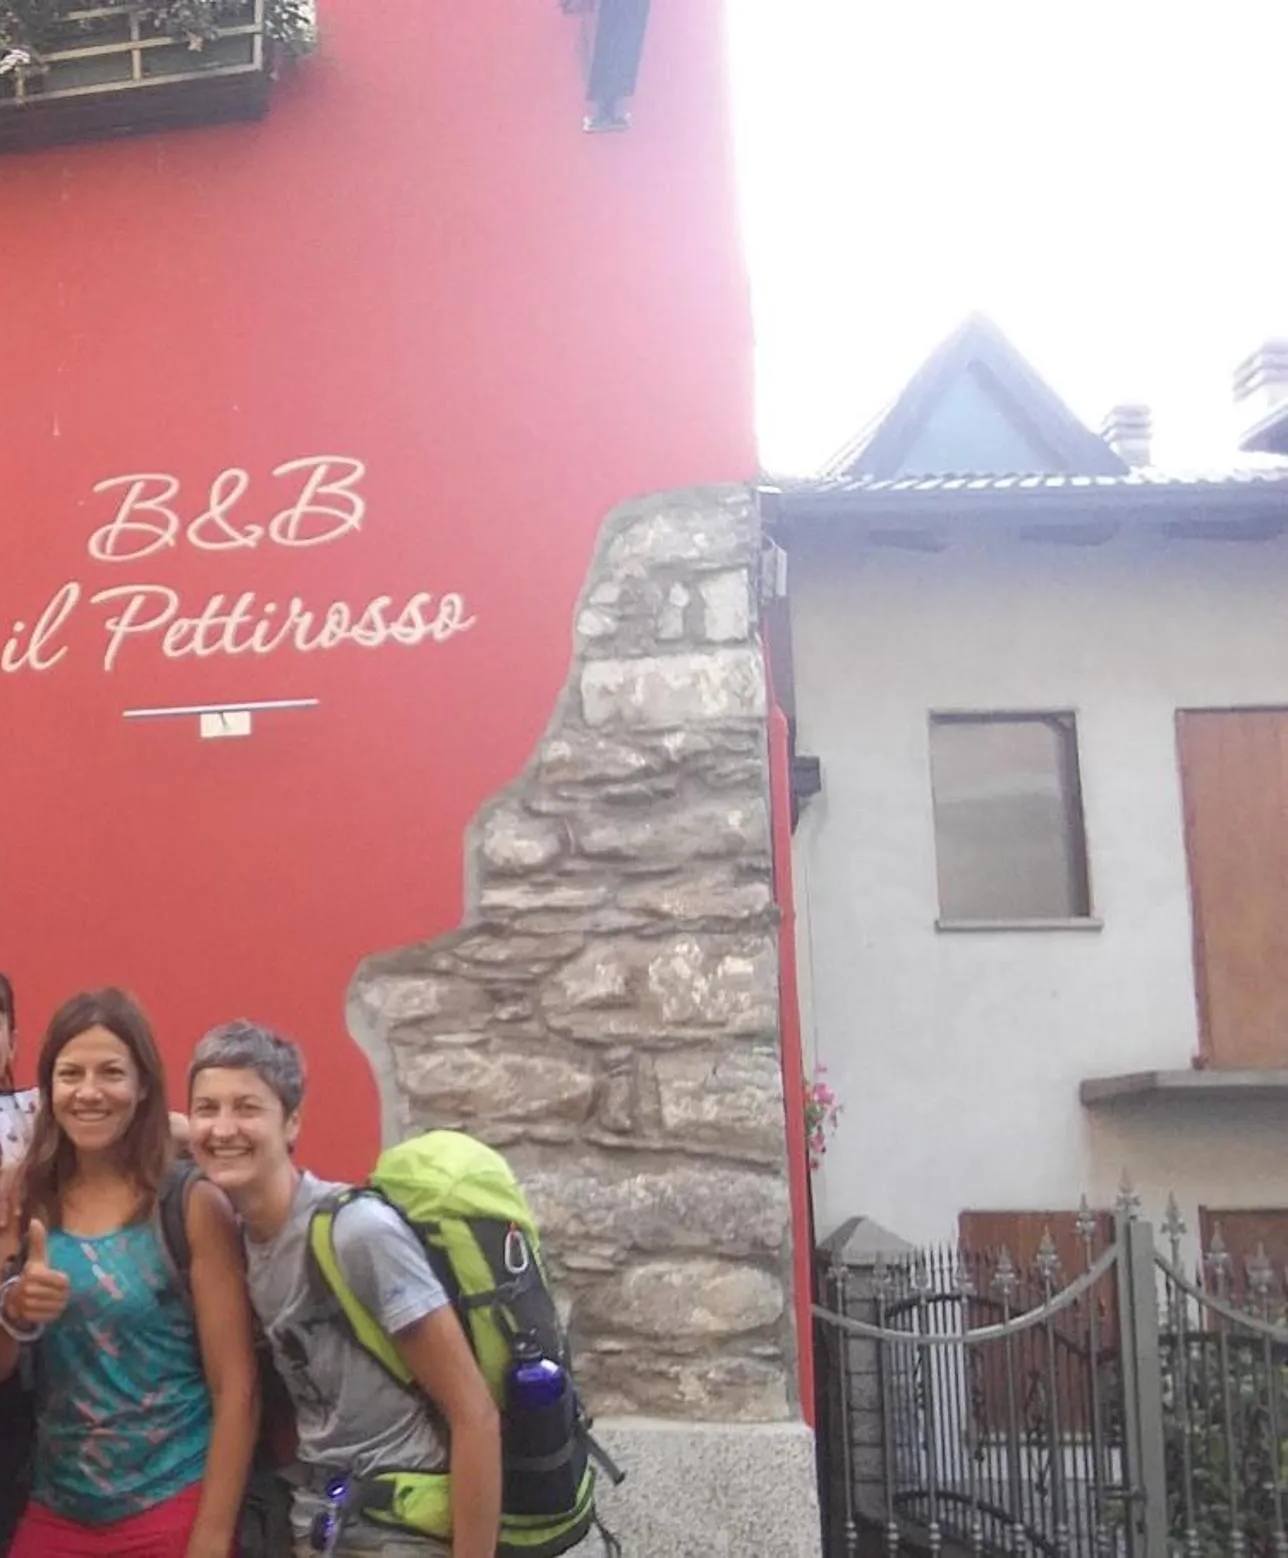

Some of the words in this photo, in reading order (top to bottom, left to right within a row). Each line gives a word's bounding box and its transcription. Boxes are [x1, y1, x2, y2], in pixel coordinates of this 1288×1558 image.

[88, 455, 366, 561] B&B
[1, 582, 80, 672] il
[90, 584, 477, 672] Pettirosso
